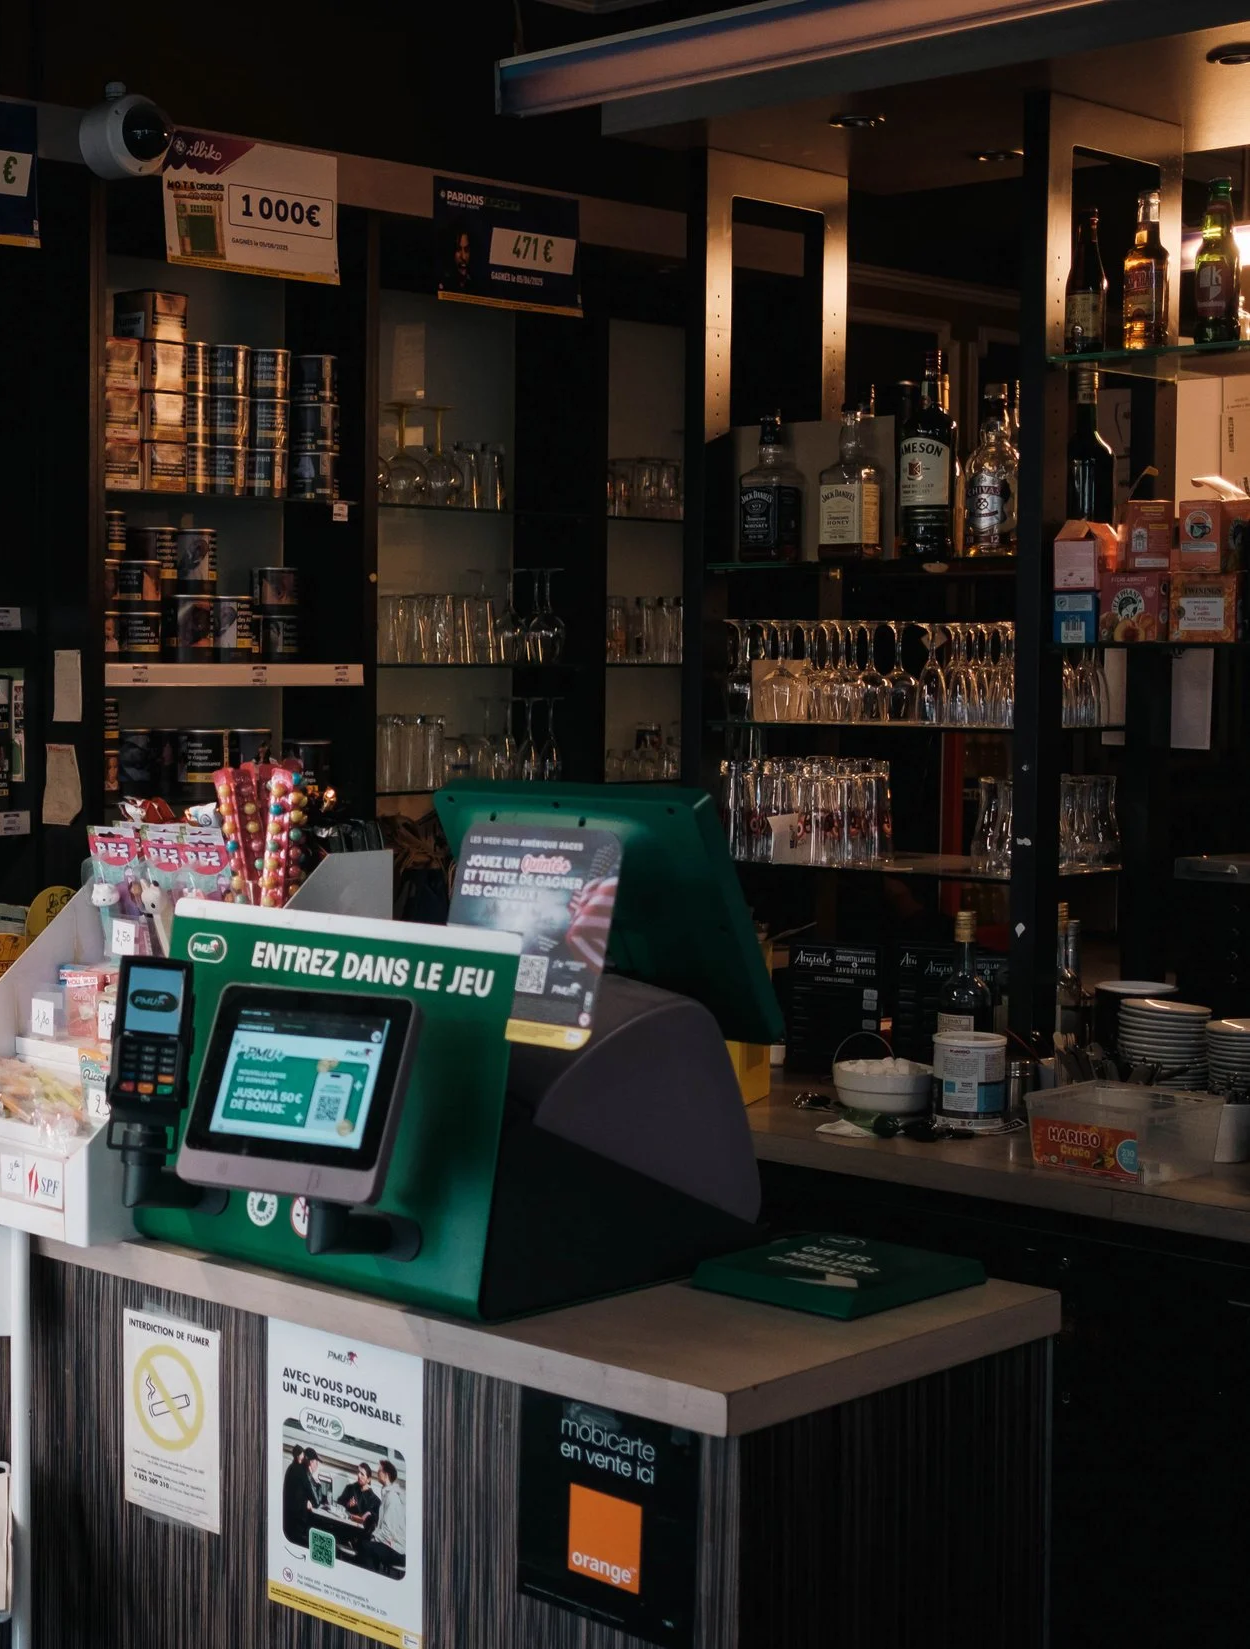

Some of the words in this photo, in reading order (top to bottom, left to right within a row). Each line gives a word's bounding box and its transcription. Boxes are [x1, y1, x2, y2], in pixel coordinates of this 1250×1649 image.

[186, 141, 222, 161] illiko
[3, 156, 18, 184] €
[241, 194, 253, 217] 1
[447, 190, 485, 206] PARIONS
[512, 235, 538, 261] 471
[543, 240, 554, 263] €
[95, 842, 129, 858] PEZ
[148, 847, 178, 865] PEZ
[185, 850, 220, 867] PEZ
[466, 854, 503, 868] JOUEZ
[504, 856, 520, 869] UN
[461, 883, 482, 896] DES
[463, 869, 477, 880] ET
[478, 870, 517, 884] TENTEZ
[518, 874, 534, 886] DE
[535, 875, 584, 890] GAGNER
[251, 941, 339, 978] ENTREZ
[342, 952, 410, 987] DANS
[413, 961, 444, 991] LE
[446, 965, 495, 998] JEU
[230, 1099, 247, 1110] DE
[1048, 1126, 1101, 1148] HARIBO
[40, 1177, 59, 1194] SPF
[129, 1317, 174, 1338] INTERDICTION
[176, 1330, 185, 1341] DE
[186, 1333, 209, 1347] FUMER
[327, 1350, 346, 1363] PMU
[282, 1367, 311, 1384] AVEC
[313, 1375, 343, 1393] VOUS
[346, 1385, 377, 1403] POUR
[282, 1381, 297, 1395] UN
[300, 1387, 320, 1401] JEU
[323, 1393, 406, 1427] RESPONSABLE.
[306, 1412, 329, 1429] PMU
[560, 1417, 655, 1464] mobicarte
[560, 1441, 581, 1461] en
[585, 1449, 632, 1478] vente
[636, 1463, 655, 1485] ici
[571, 1551, 632, 1586] orange
